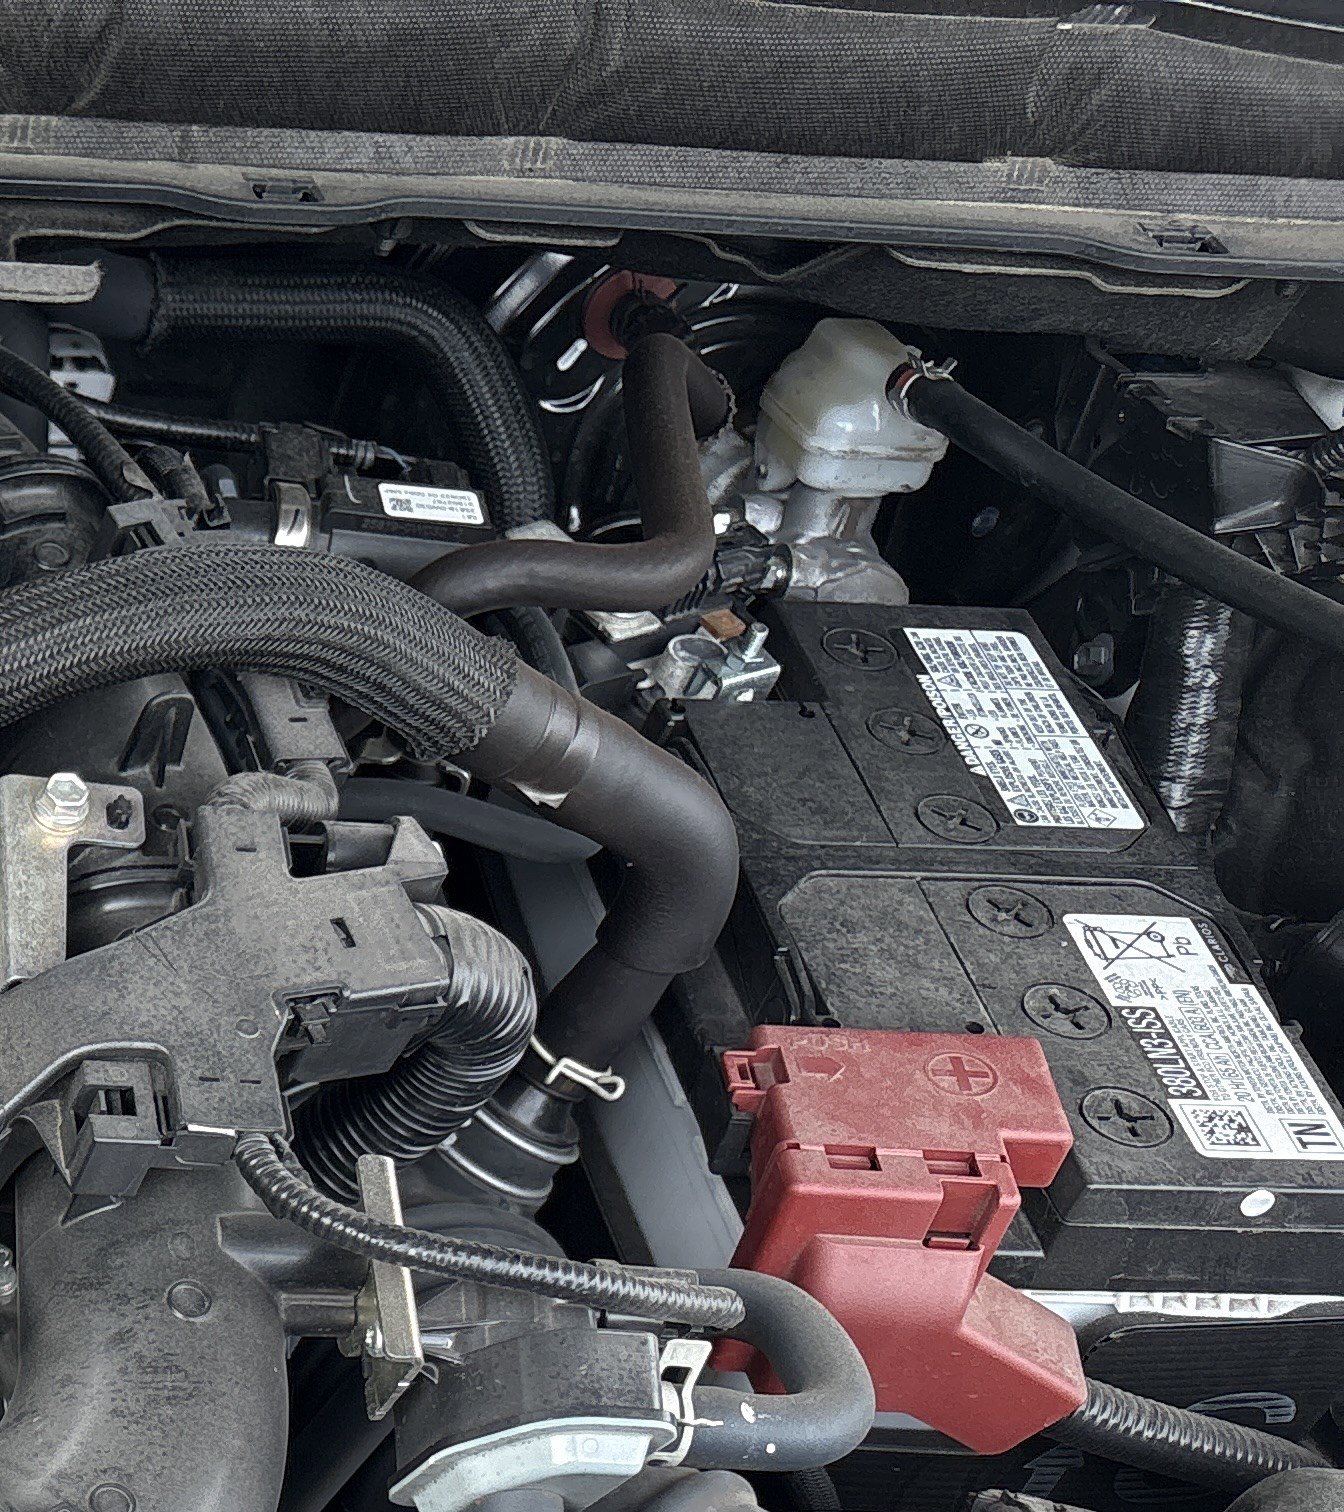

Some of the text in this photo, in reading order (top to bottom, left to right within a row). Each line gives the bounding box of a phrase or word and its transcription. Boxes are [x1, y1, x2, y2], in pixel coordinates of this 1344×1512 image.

[1173, 936, 1198, 957] Pb
[1197, 922, 1230, 965] CLARIOS
[1120, 1007, 1203, 1098] 380LN3-ISS
[1288, 1122, 1338, 1150] TN
